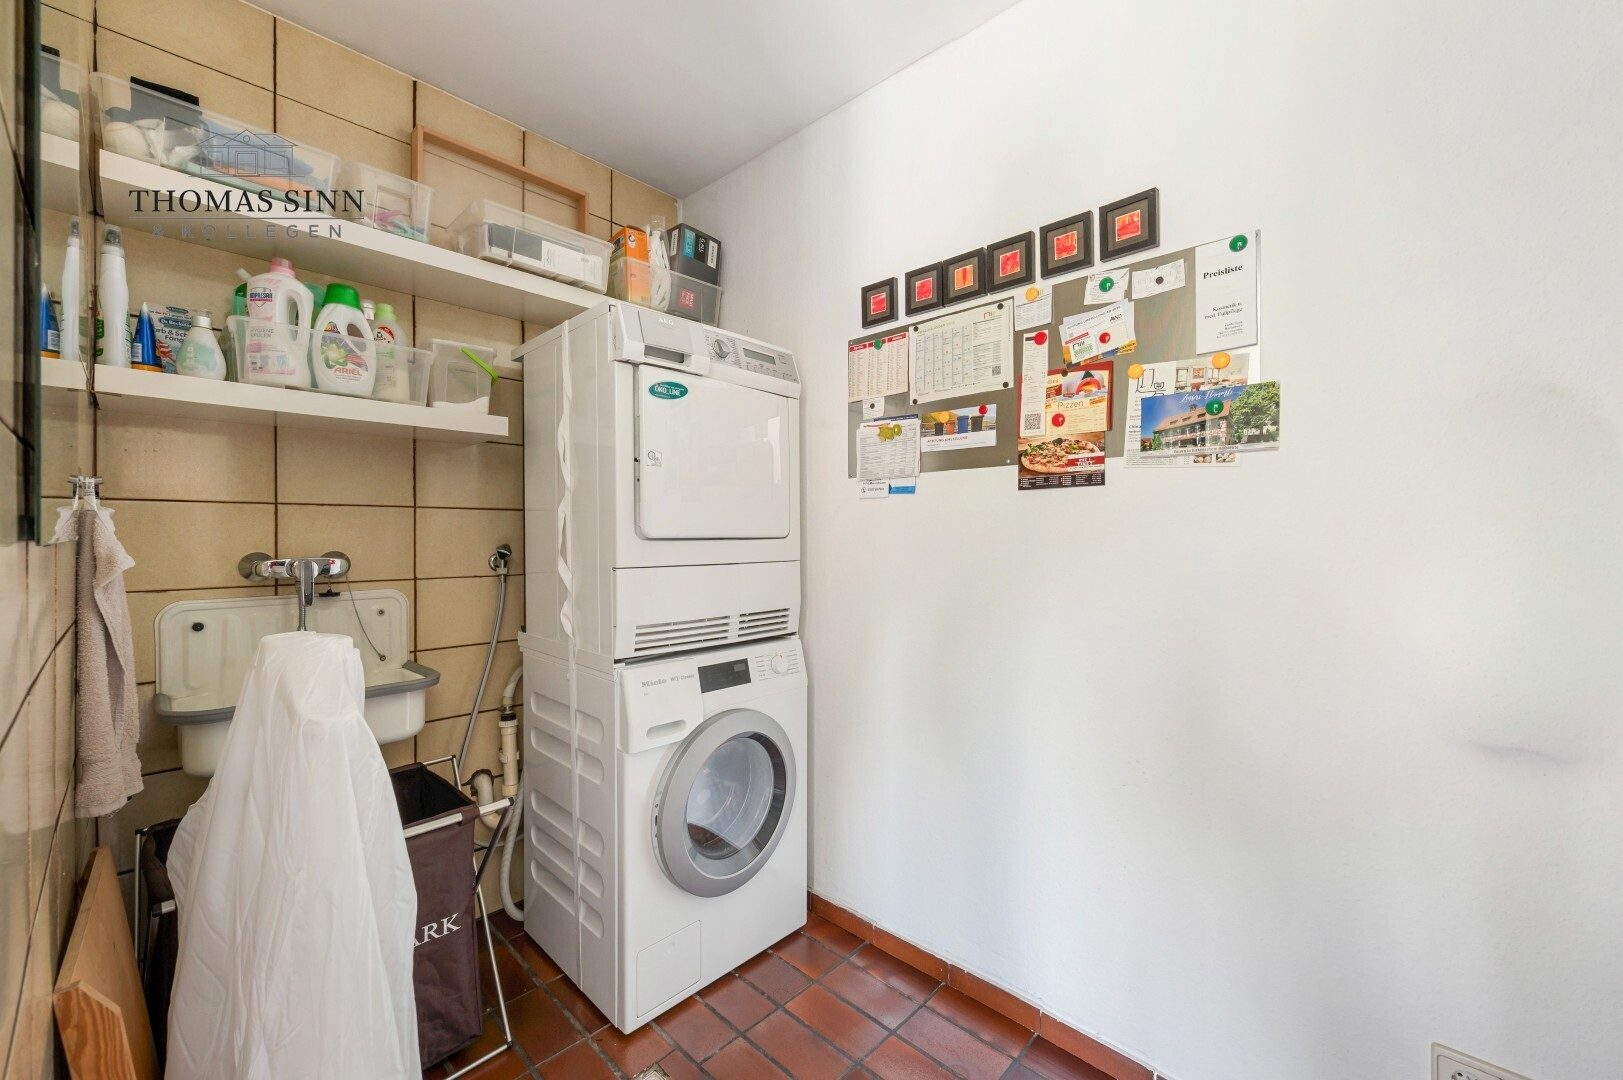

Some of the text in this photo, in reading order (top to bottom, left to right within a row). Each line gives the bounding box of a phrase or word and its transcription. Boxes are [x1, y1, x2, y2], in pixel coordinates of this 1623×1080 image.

[1203, 264, 1243, 280] Preisliste
[334, 367, 362, 377] ARIEL
[1057, 401, 1084, 410] Pizzen
